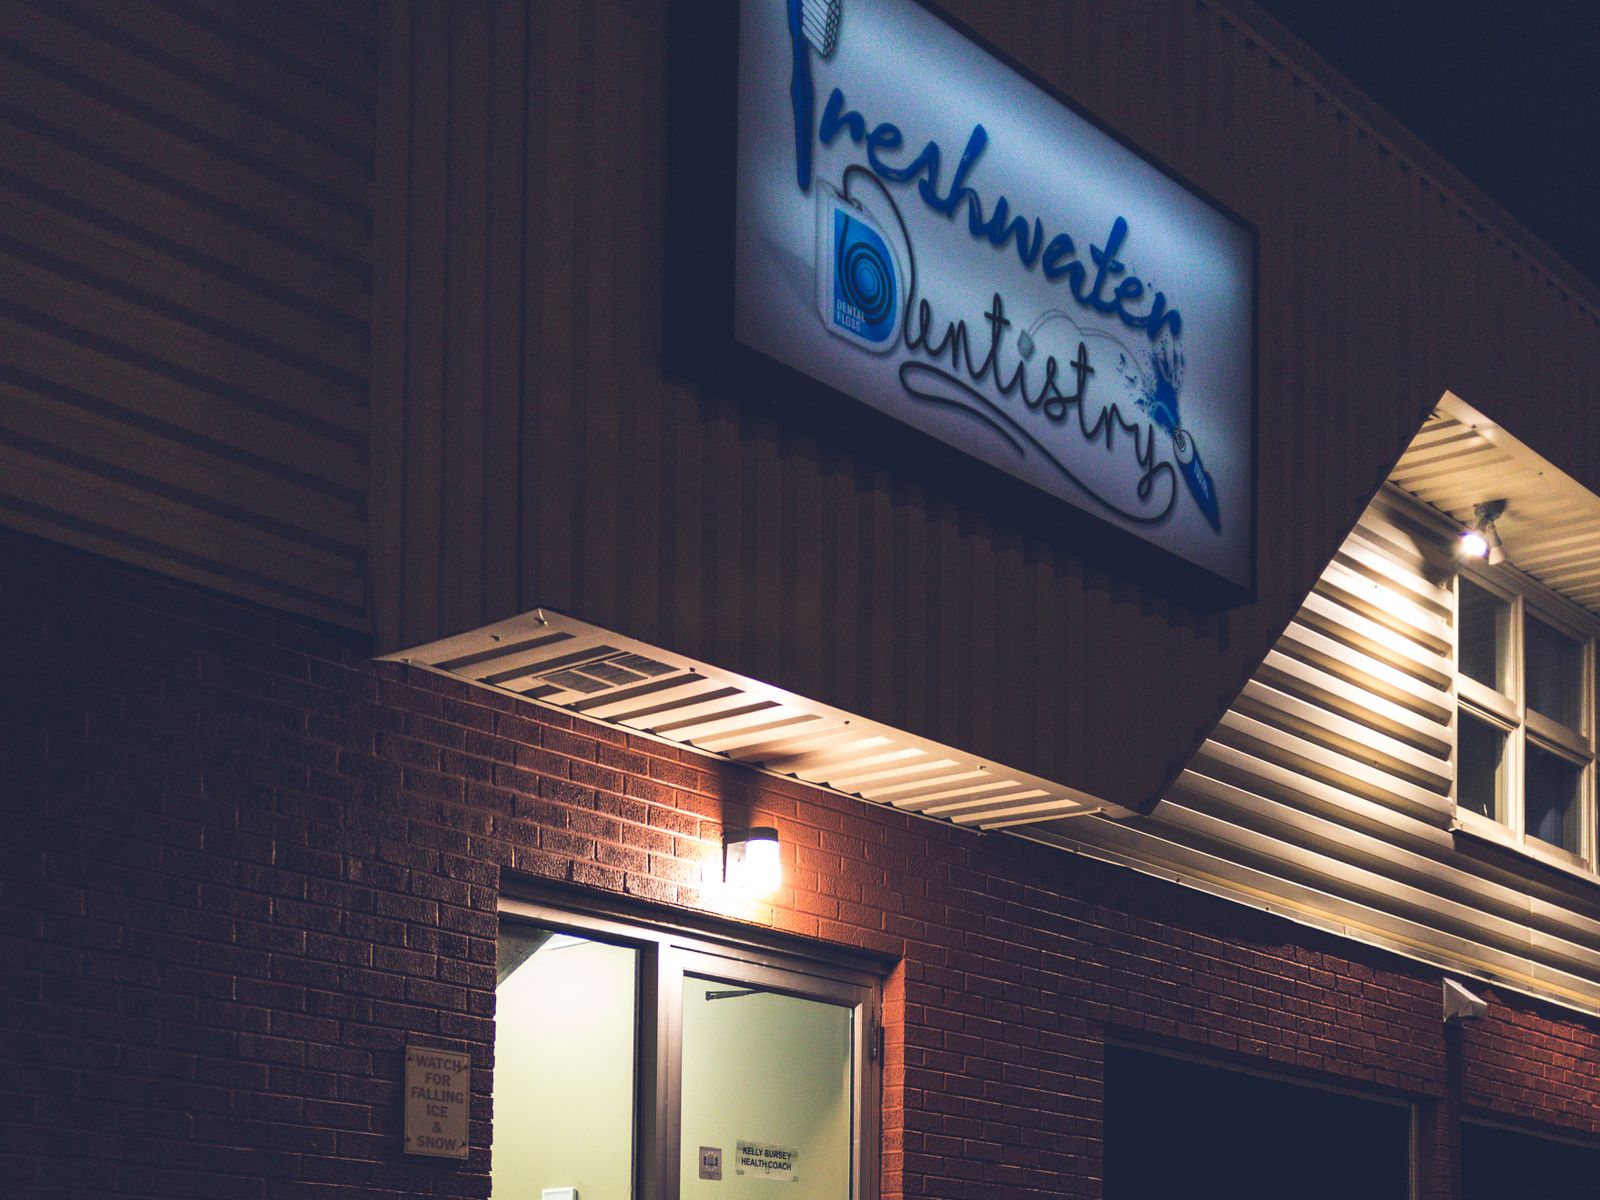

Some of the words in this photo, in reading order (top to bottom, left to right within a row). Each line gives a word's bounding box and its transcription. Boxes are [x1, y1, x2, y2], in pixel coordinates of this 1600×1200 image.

[837, 299, 866, 324] DENTAL
[836, 310, 861, 333] FLOSS
[415, 1054, 461, 1073] WATCH
[424, 1072, 451, 1087] FOR
[410, 1086, 464, 1105] FALLING
[426, 1103, 449, 1119] ICE
[432, 1121, 442, 1133] &
[416, 1135, 457, 1151] SNOW
[742, 1147, 763, 1157] KELLY
[764, 1149, 791, 1161] BURSEY
